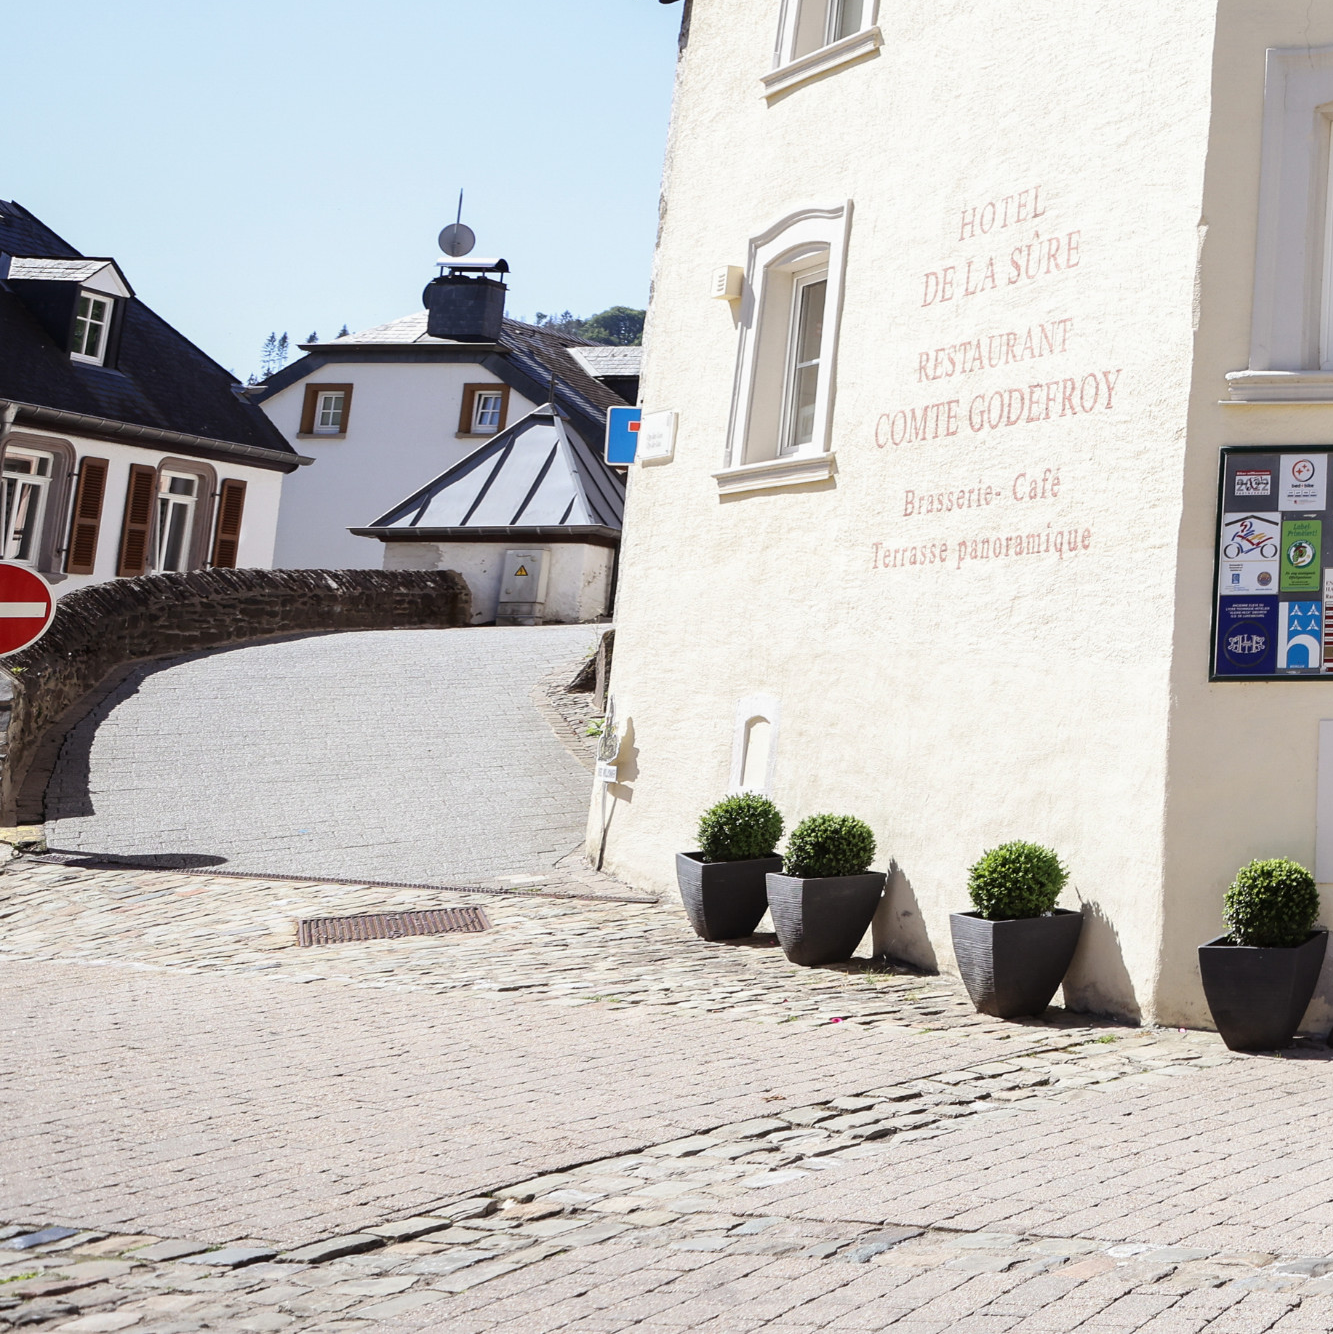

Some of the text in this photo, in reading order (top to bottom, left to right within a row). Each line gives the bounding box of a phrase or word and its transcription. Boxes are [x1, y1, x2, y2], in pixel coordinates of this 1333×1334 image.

[958, 185, 1046, 241] HOTEL
[921, 230, 1083, 308] DE LA SÛRE
[916, 317, 1074, 384] RESTAURANT
[874, 368, 1124, 450] COMTE GODEFROY
[1011, 467, 1063, 503] Café
[870, 523, 1092, 570] Terrasse panoramique
